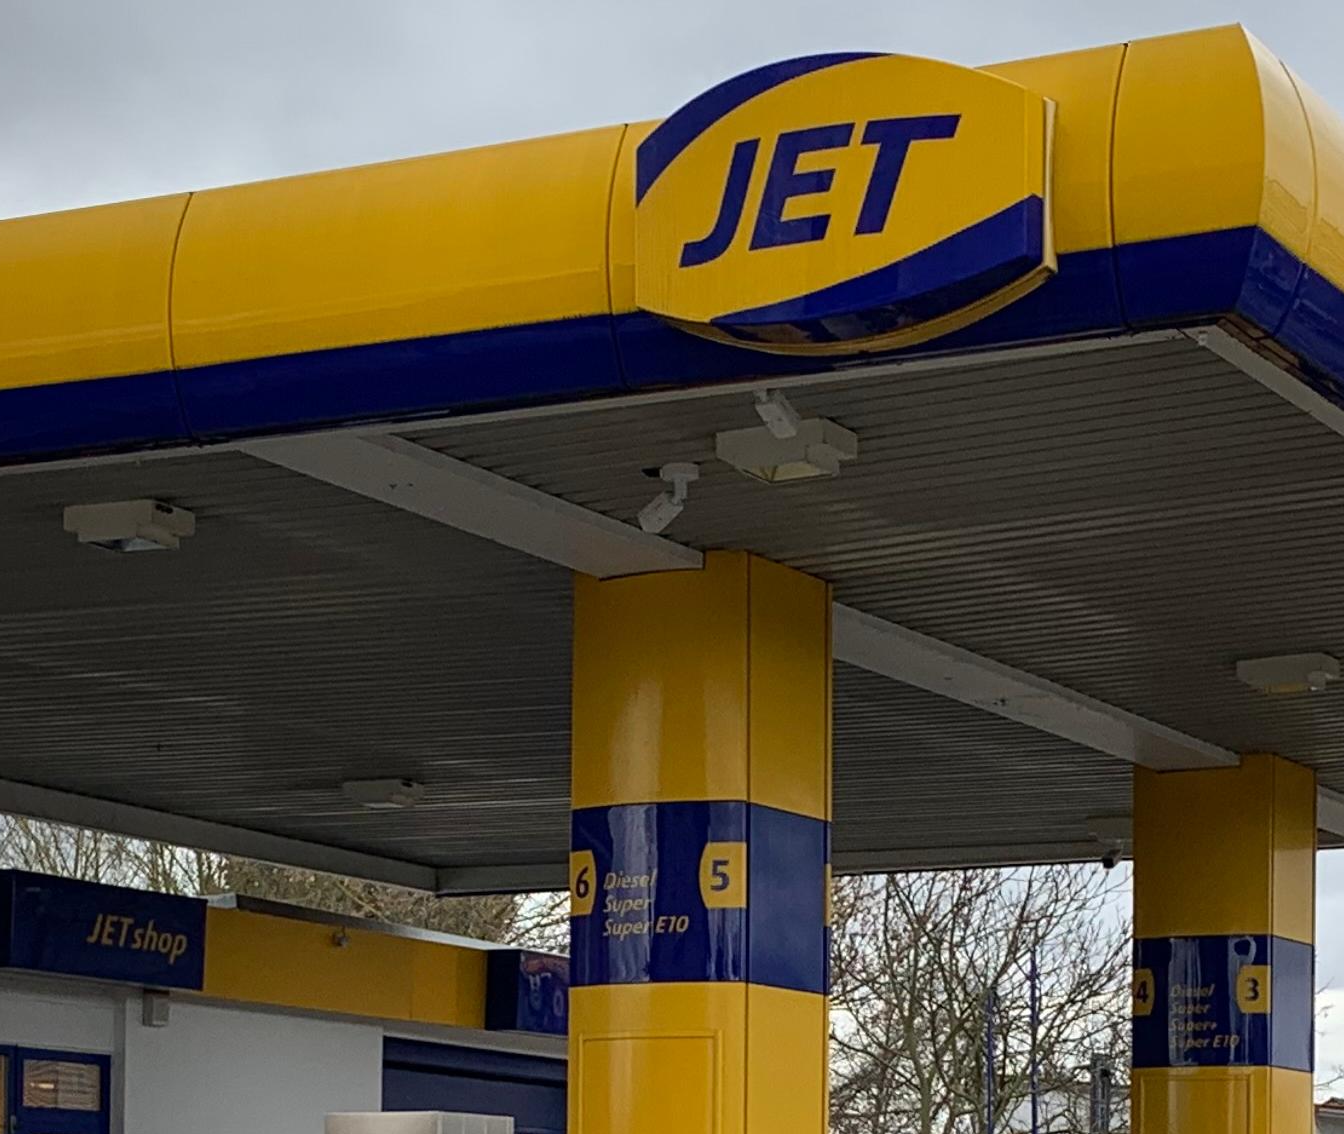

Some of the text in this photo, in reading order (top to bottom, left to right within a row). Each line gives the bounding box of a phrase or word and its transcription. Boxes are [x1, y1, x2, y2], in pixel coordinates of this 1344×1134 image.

[679, 114, 961, 268] JET
[575, 860, 730, 899] 6 5
[603, 869, 656, 889] Diesel
[603, 895, 652, 914] Super
[603, 916, 689, 941] Super E10
[1135, 977, 1260, 1004] 4 3
